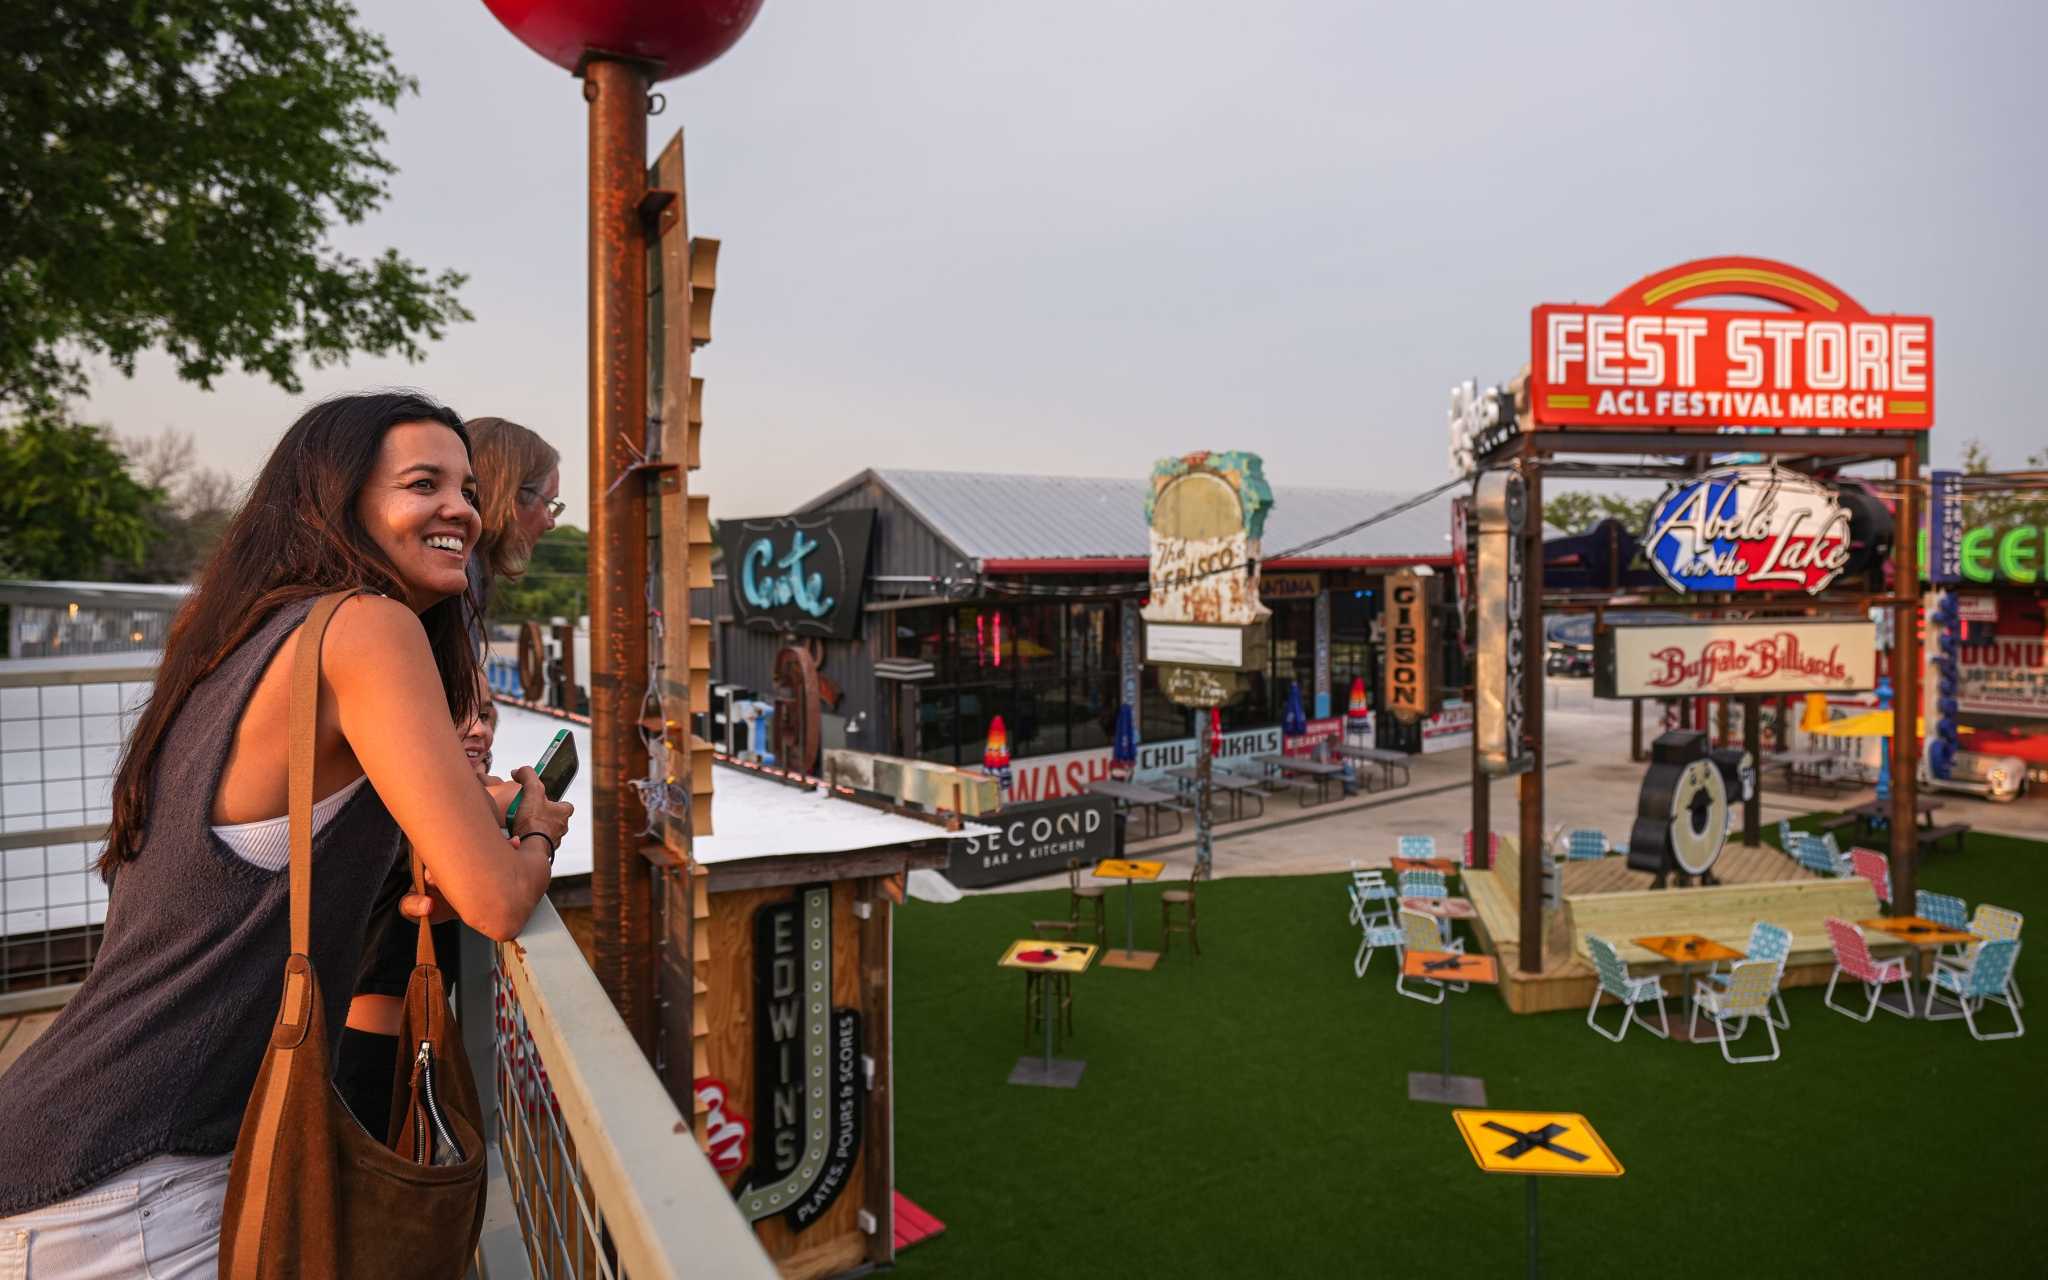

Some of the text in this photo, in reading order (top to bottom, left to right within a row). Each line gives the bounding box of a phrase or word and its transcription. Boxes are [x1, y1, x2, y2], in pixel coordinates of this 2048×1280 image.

[1547, 313, 1926, 391] FEST STORE
[1596, 390, 1884, 419] ACL FESTIVAL MERCH
[1163, 548, 1234, 594] FRISCO
[1680, 507, 1852, 585] on the Lake
[1394, 586, 1416, 704] GIBSON
[1507, 535, 1522, 758] LUCKY
[1646, 631, 1846, 688] Buffalo Billiards
[966, 809, 1100, 855] SECOND
[984, 852, 1009, 868] BAR
[1030, 838, 1086, 860] KITCHEN
[768, 912, 798, 1171] EDWINS
[839, 1016, 854, 1083] SCORES
[836, 1100, 854, 1158] POURS
[797, 1163, 846, 1222] PLATES,
